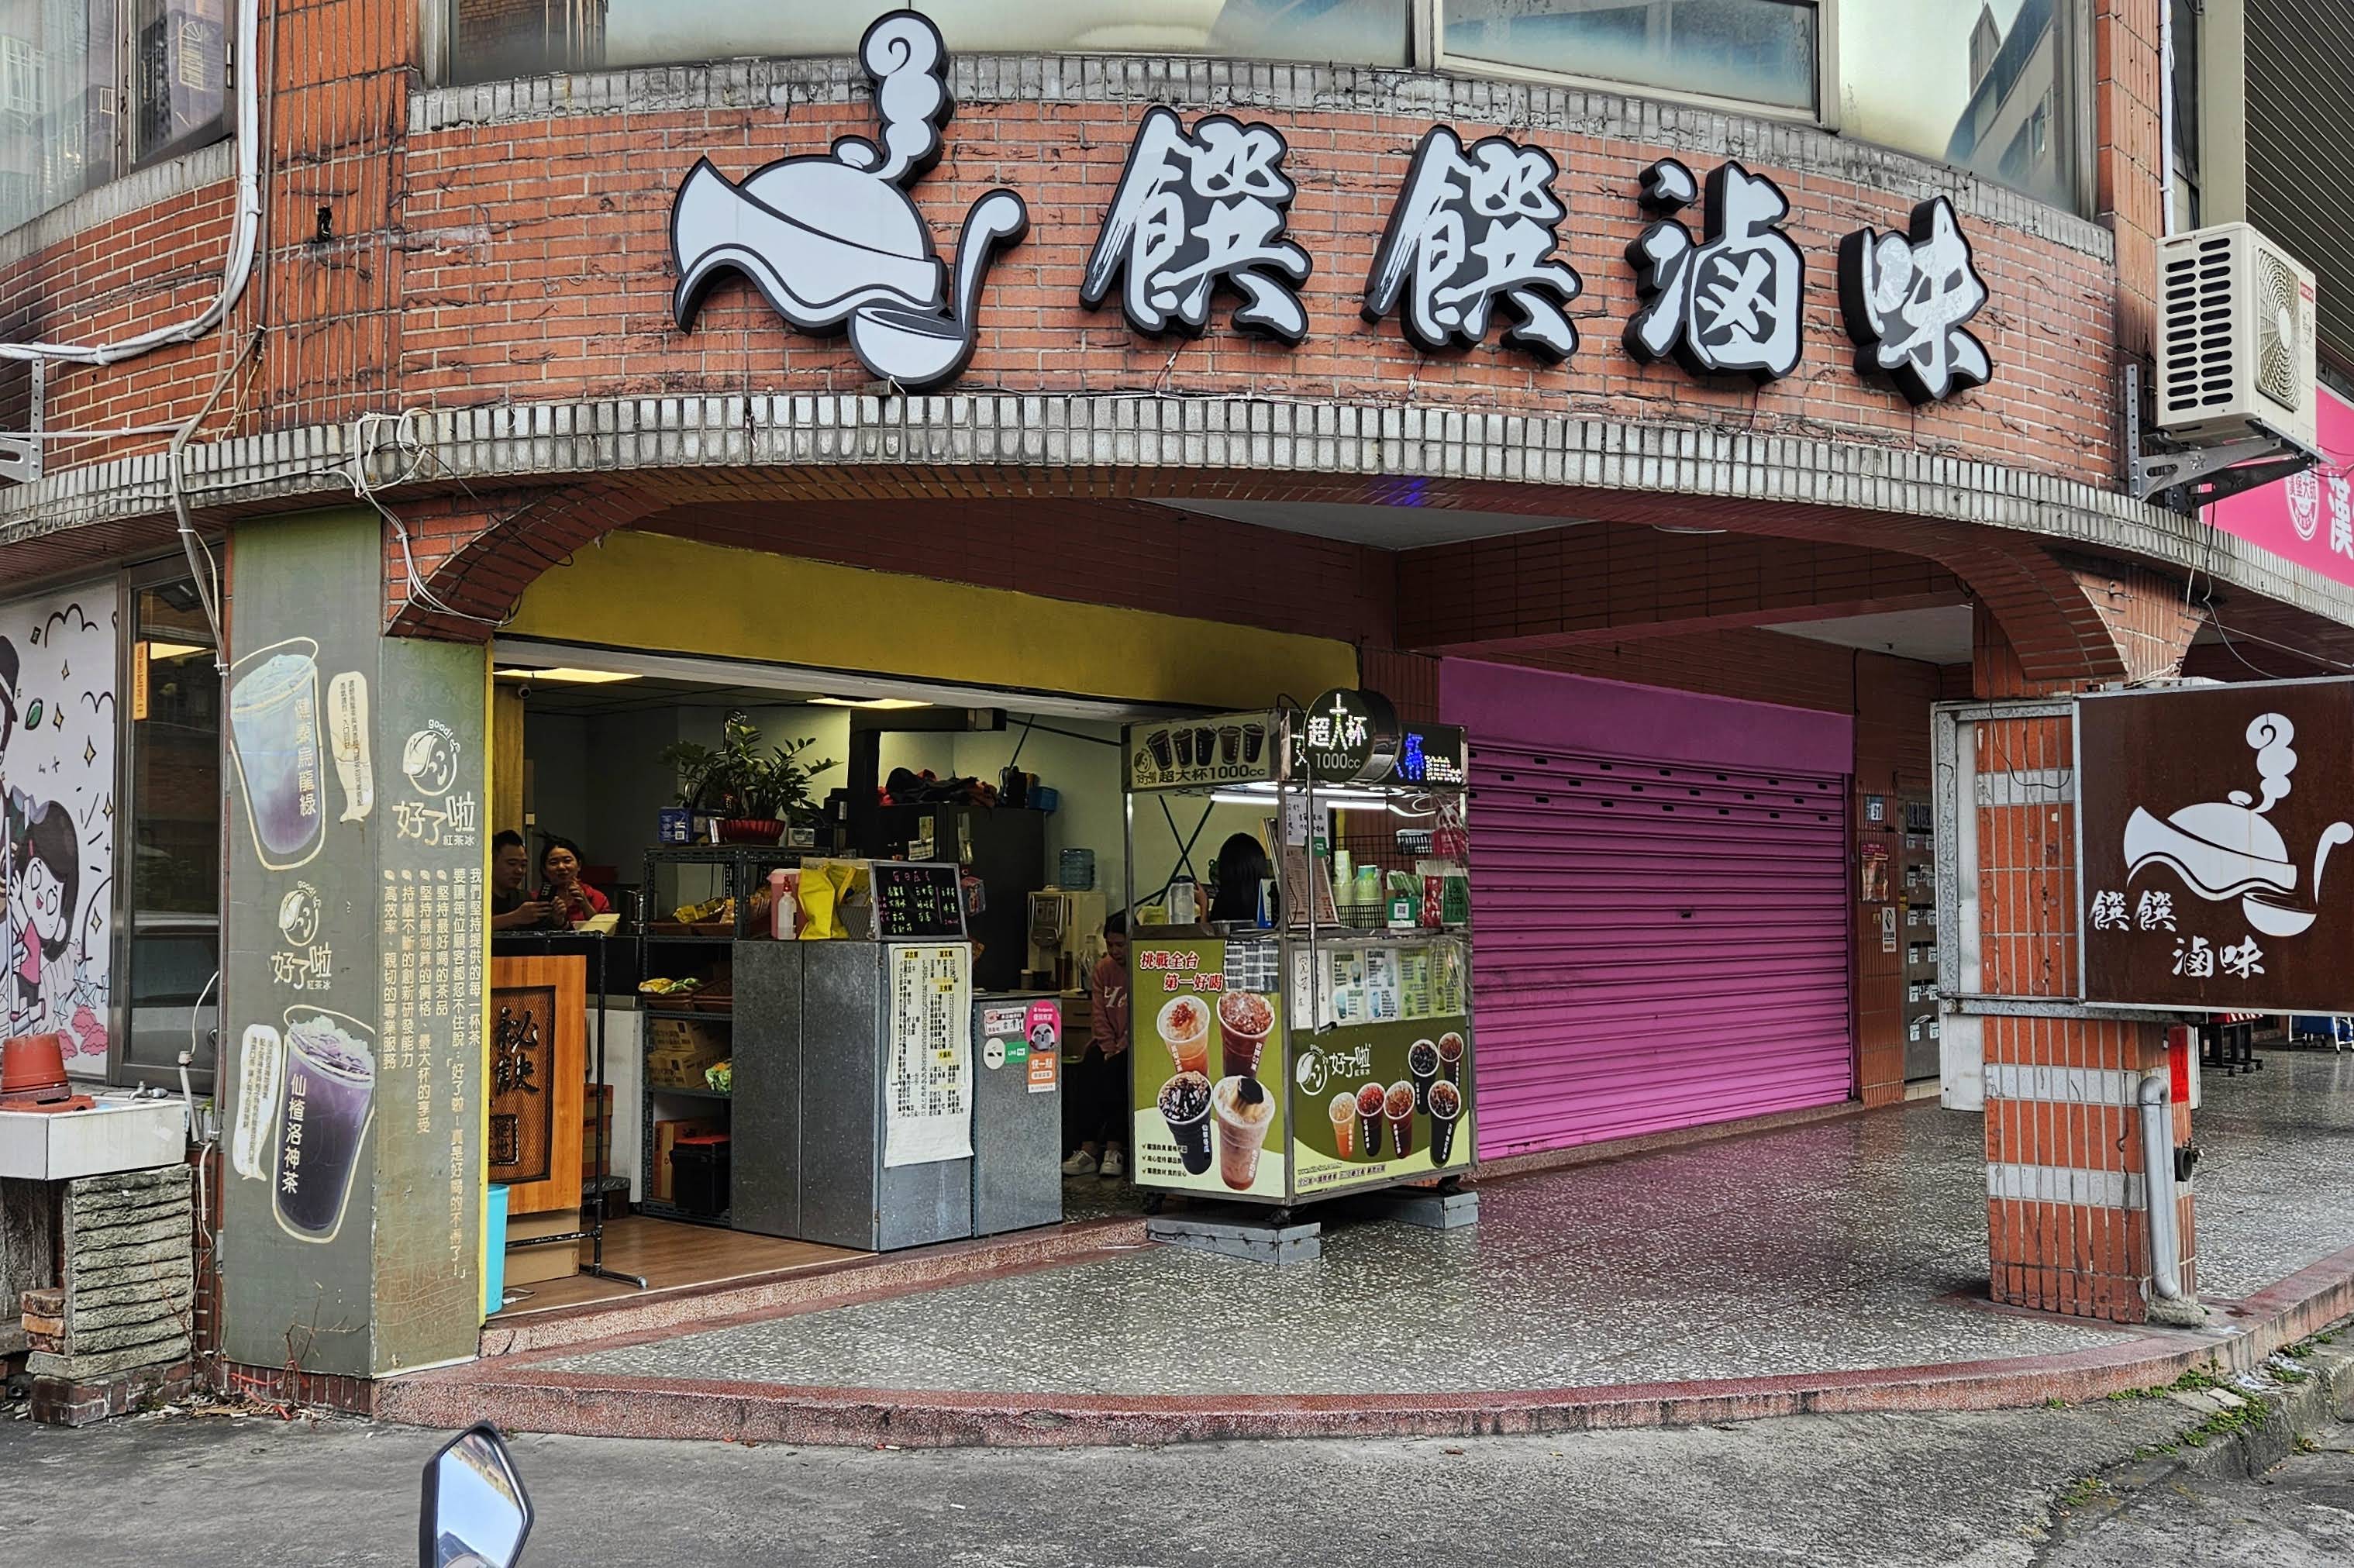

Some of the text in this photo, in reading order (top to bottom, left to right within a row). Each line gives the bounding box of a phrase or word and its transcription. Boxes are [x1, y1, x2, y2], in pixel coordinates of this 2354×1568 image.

[1080, 105, 1993, 404] 饌饌滷味
[1308, 693, 1367, 750] 超大杯
[1159, 764, 1265, 783] 超大杯1000cc
[1315, 753, 1361, 770] 1000cc
[391, 791, 476, 846] 好了啦
[443, 835, 476, 846] 紅茶冰
[2088, 890, 2177, 932] 饌饌
[271, 942, 332, 990] 好了啦
[436, 885, 450, 1016] 堅持最好喝的茶品
[468, 867, 482, 1046] 我們堅持提供的每一杯茶
[1139, 951, 1200, 970] 挑戰全台
[2172, 935, 2265, 979] 滷味
[1163, 973, 1224, 992] 第一好喝
[1329, 1042, 1370, 1077] 好了啦
